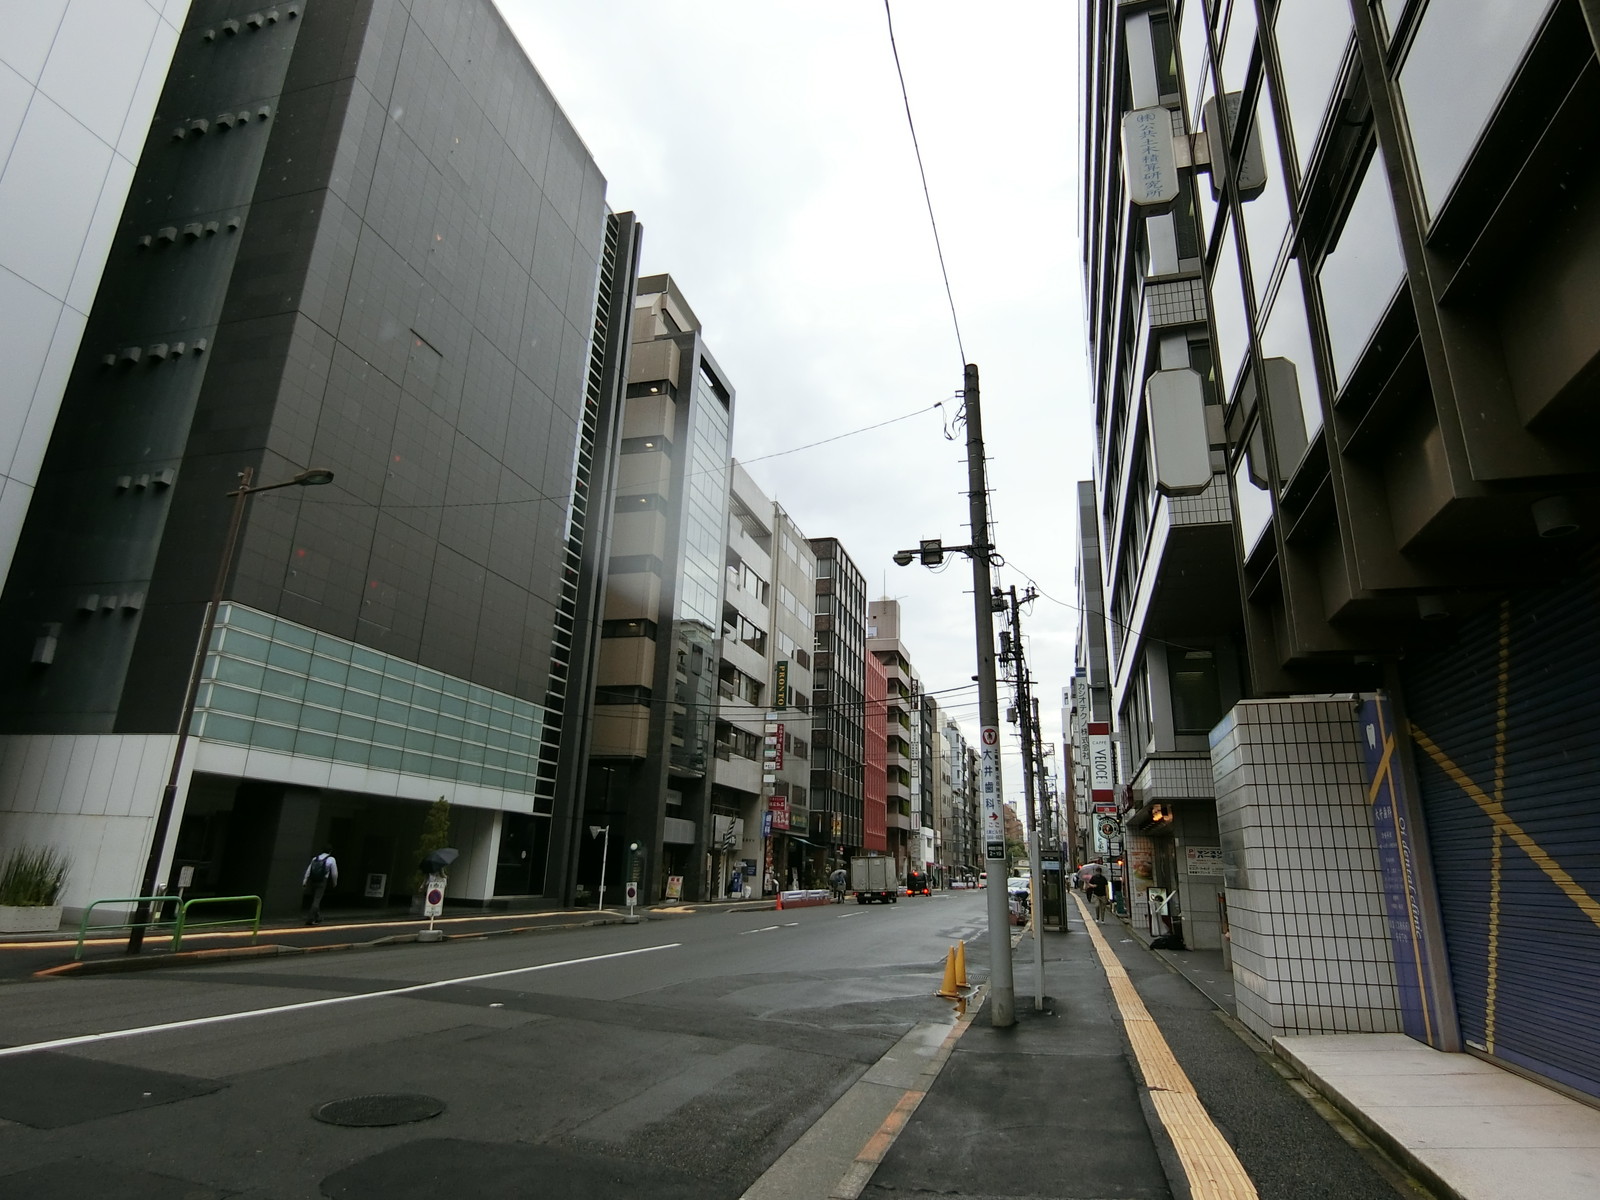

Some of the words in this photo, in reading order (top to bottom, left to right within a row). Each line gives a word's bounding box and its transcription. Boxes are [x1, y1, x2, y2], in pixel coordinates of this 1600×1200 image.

[777, 665, 787, 707] PRONTO
[1077, 683, 1090, 760] カシオテクノ株式会社
[983, 748, 995, 810] 大井歯科
[1094, 748, 1109, 780] VELOCE
[1401, 839, 1417, 895] dental
